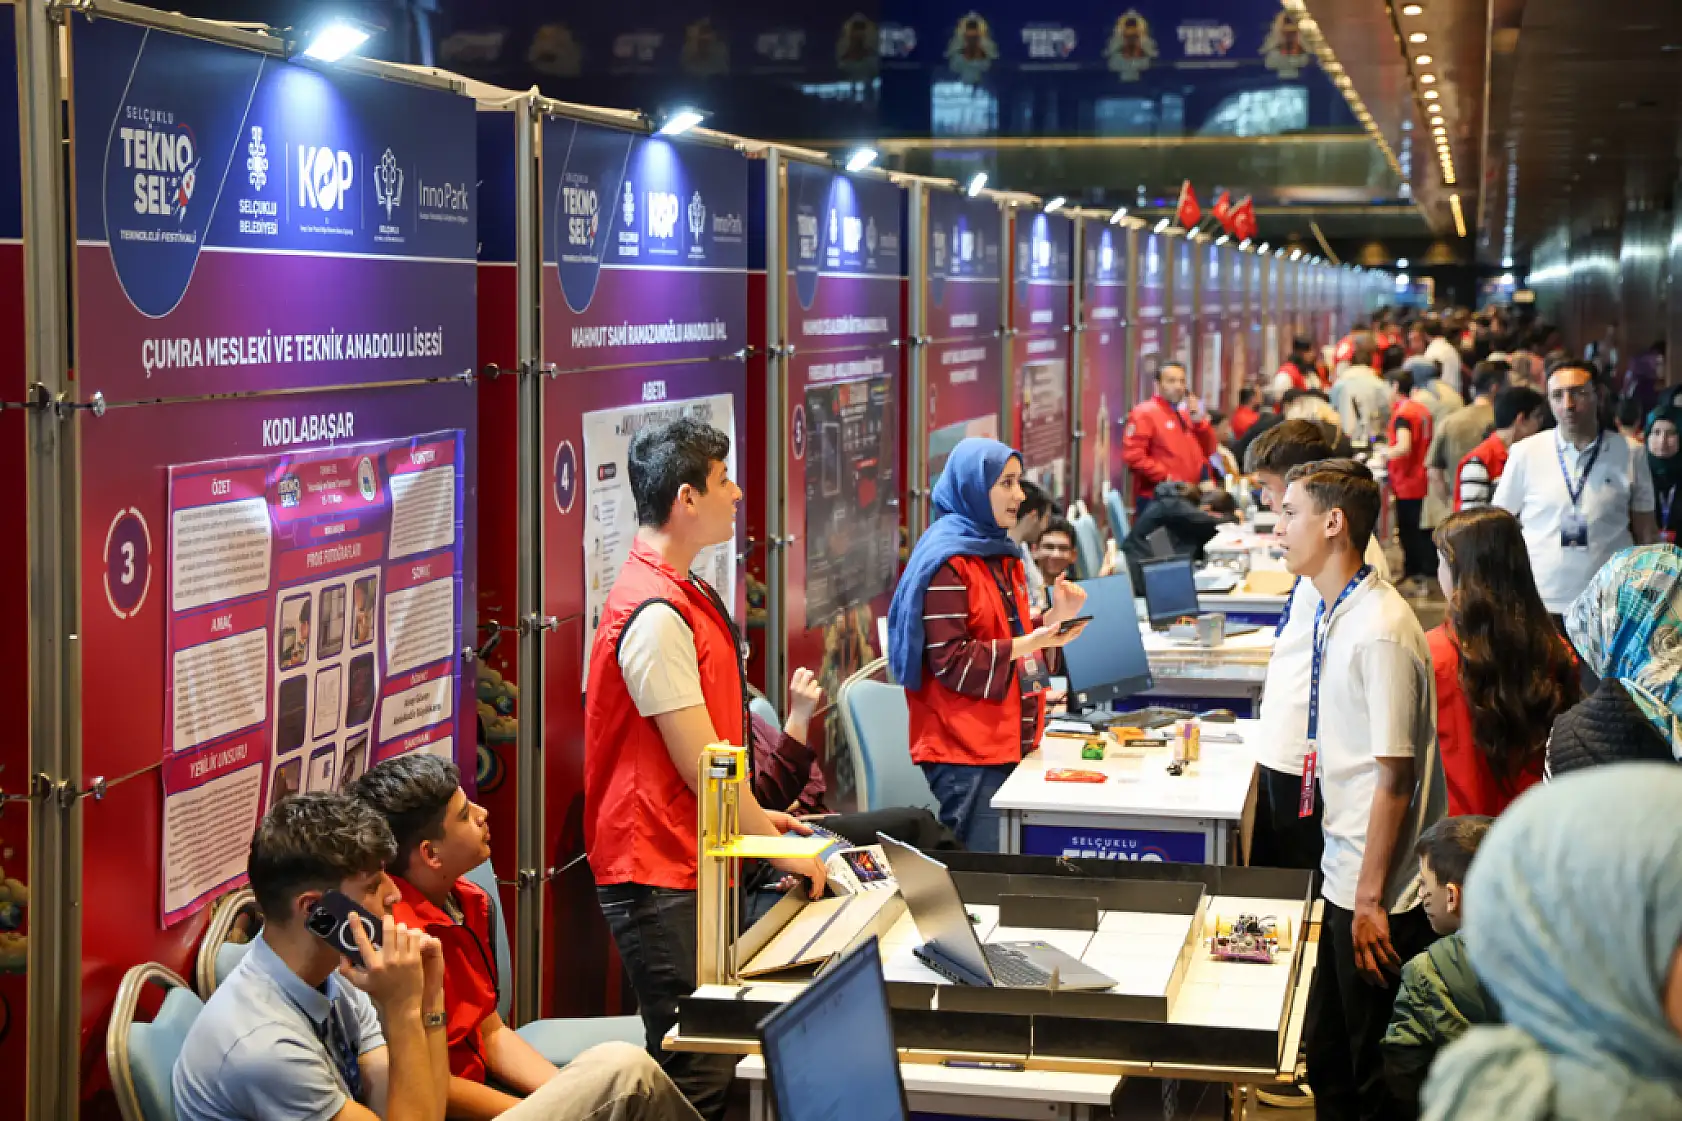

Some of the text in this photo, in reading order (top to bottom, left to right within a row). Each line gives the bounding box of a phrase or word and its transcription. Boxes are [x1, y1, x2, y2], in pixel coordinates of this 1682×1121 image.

[126, 105, 174, 125] SELÇUKLU
[120, 125, 194, 173] TEKNO
[133, 173, 171, 216] SEL
[298, 144, 354, 212] KOP
[418, 178, 469, 211] InnoPark
[238, 198, 278, 217] SELÇUKLU
[142, 325, 443, 378] ÇUMRA MESLEKİ VE TEKNİK ANADOLU LİSESİ
[262, 411, 354, 447] KODLABAŞAR
[210, 478, 232, 495] ÖZET
[561, 462, 570, 490] 4
[120, 540, 135, 585] 3
[1072, 836, 1137, 849] SELÇUKLU
